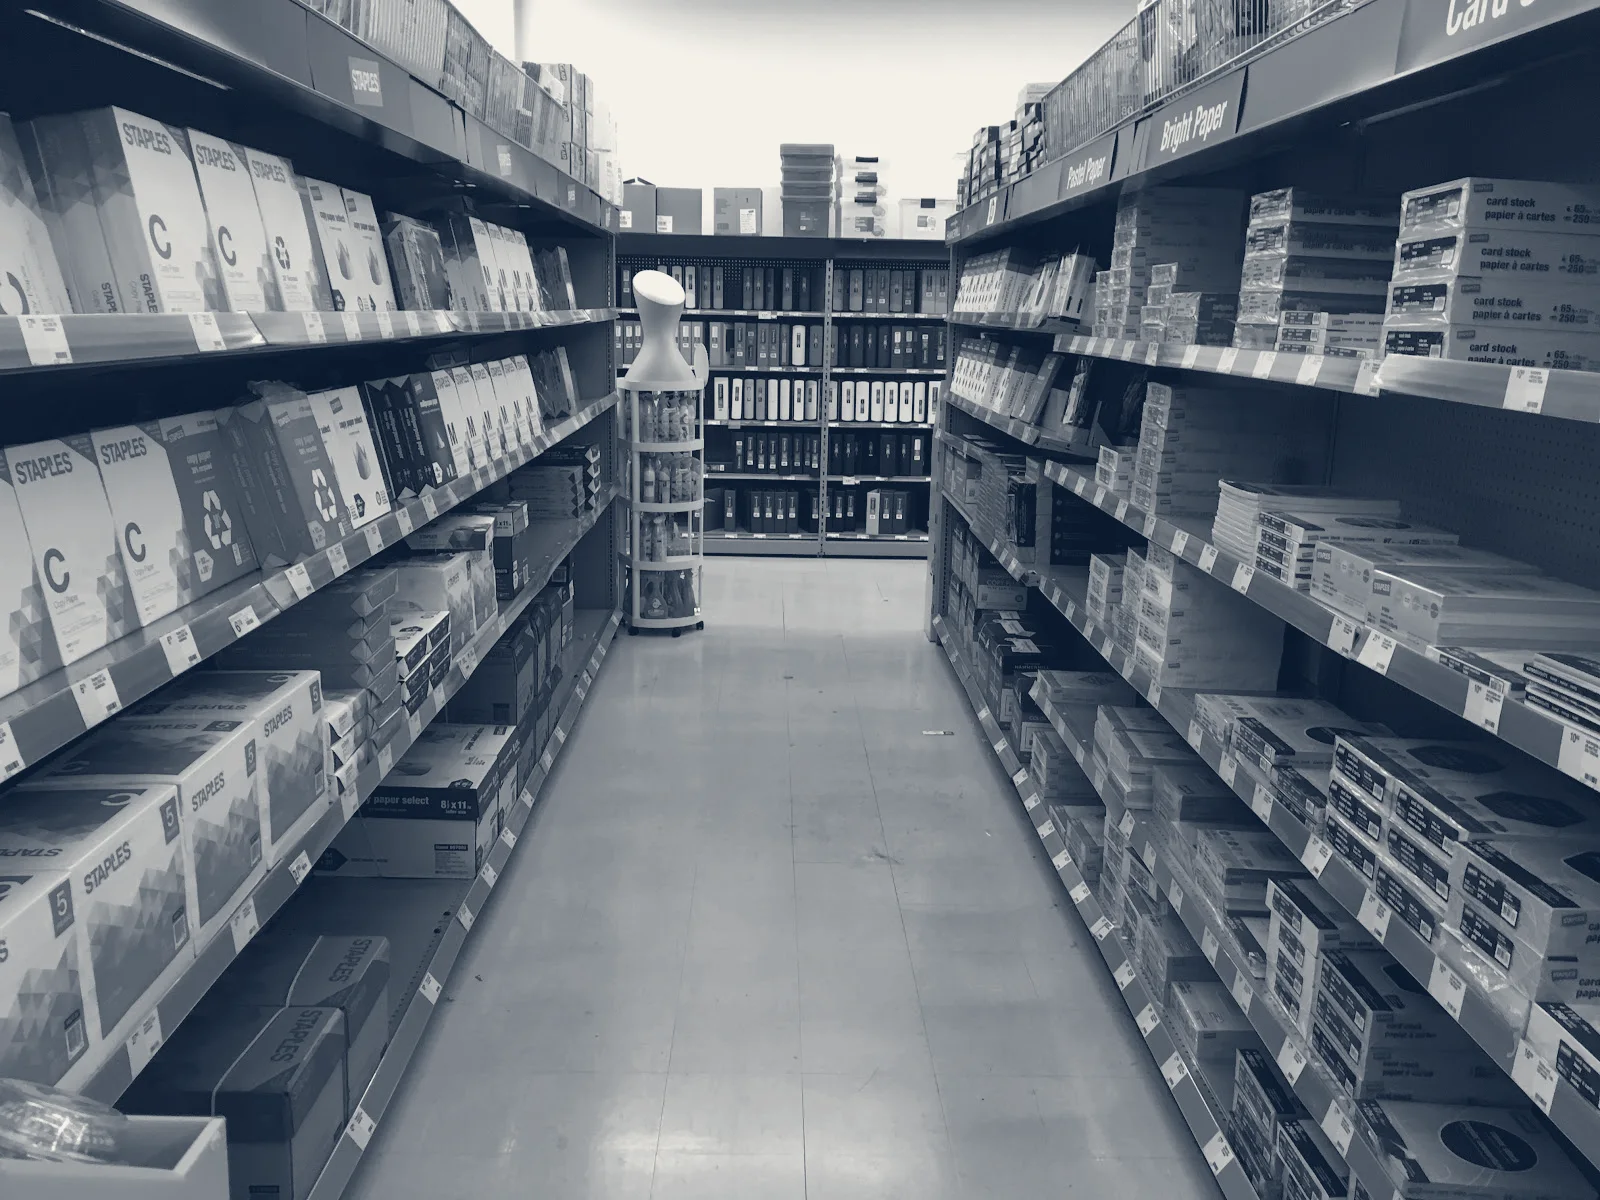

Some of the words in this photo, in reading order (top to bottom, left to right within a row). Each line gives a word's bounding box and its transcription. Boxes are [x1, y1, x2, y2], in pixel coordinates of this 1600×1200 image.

[352, 69, 380, 93] STAPLES
[122, 122, 172, 155] STAPLES
[1160, 112, 1193, 153] Bright
[1192, 100, 1228, 140] Paper
[195, 143, 236, 172] STAPLES
[251, 159, 286, 184] STAPLES
[1067, 160, 1087, 190] Pastel
[1085, 156, 1106, 185] Paper
[1486, 197, 1508, 206] card
[1510, 198, 1536, 208] stock
[1485, 210, 1515, 221] papier
[1526, 212, 1556, 222] cartes
[149, 214, 172, 260] C
[218, 225, 237, 267] C
[1481, 247, 1503, 256] card
[1505, 248, 1531, 257] stock
[1480, 260, 1510, 270] papier
[1512, 261, 1518, 270] à
[1520, 262, 1550, 271] cartes
[1473, 297, 1495, 306] card
[1497, 298, 1522, 307] stock
[1561, 304, 1571, 313] 65
[1472, 310, 1503, 320] papier
[1504, 310, 1510, 320] à
[1512, 311, 1542, 321] cartes
[1559, 313, 1575, 323] 250
[1469, 343, 1490, 352] card
[1491, 344, 1517, 354] stock
[1554, 350, 1565, 359] 65
[1498, 355, 1504, 365] à
[1506, 357, 1536, 367] cartes
[1552, 360, 1569, 369] 250
[100, 436, 147, 465] STAPLES
[15, 451, 73, 485] STAPLES
[125, 522, 146, 562] C
[1317, 551, 1331, 560] STAPLES
[43, 547, 70, 593] C
[1373, 582, 1391, 593] STAPLES
[264, 705, 293, 738] STAPLES
[247, 746, 254, 762] 5
[191, 772, 225, 812] STAPLES
[402, 796, 430, 806] select
[165, 805, 174, 827] 5
[84, 841, 132, 894] STAPLES
[56, 889, 68, 916] 5
[329, 938, 373, 982] STAPLES
[270, 1009, 323, 1062] STAPLES
